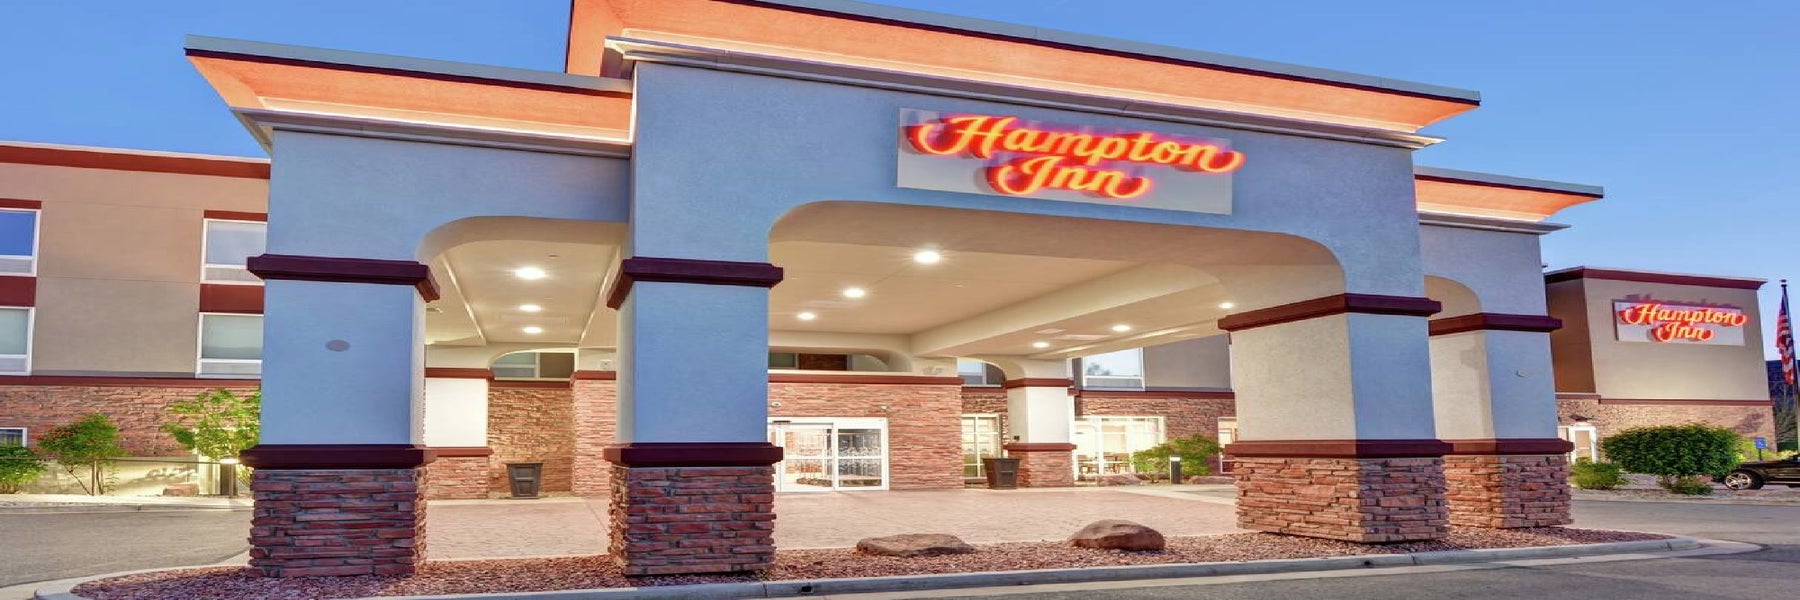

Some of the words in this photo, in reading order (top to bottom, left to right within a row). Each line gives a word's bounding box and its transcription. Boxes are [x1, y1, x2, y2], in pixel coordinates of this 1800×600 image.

[908, 114, 1244, 173] Hampton
[987, 155, 1150, 198] Inn
[1620, 304, 1747, 326] Hampton
[1652, 322, 1714, 342] Inn
